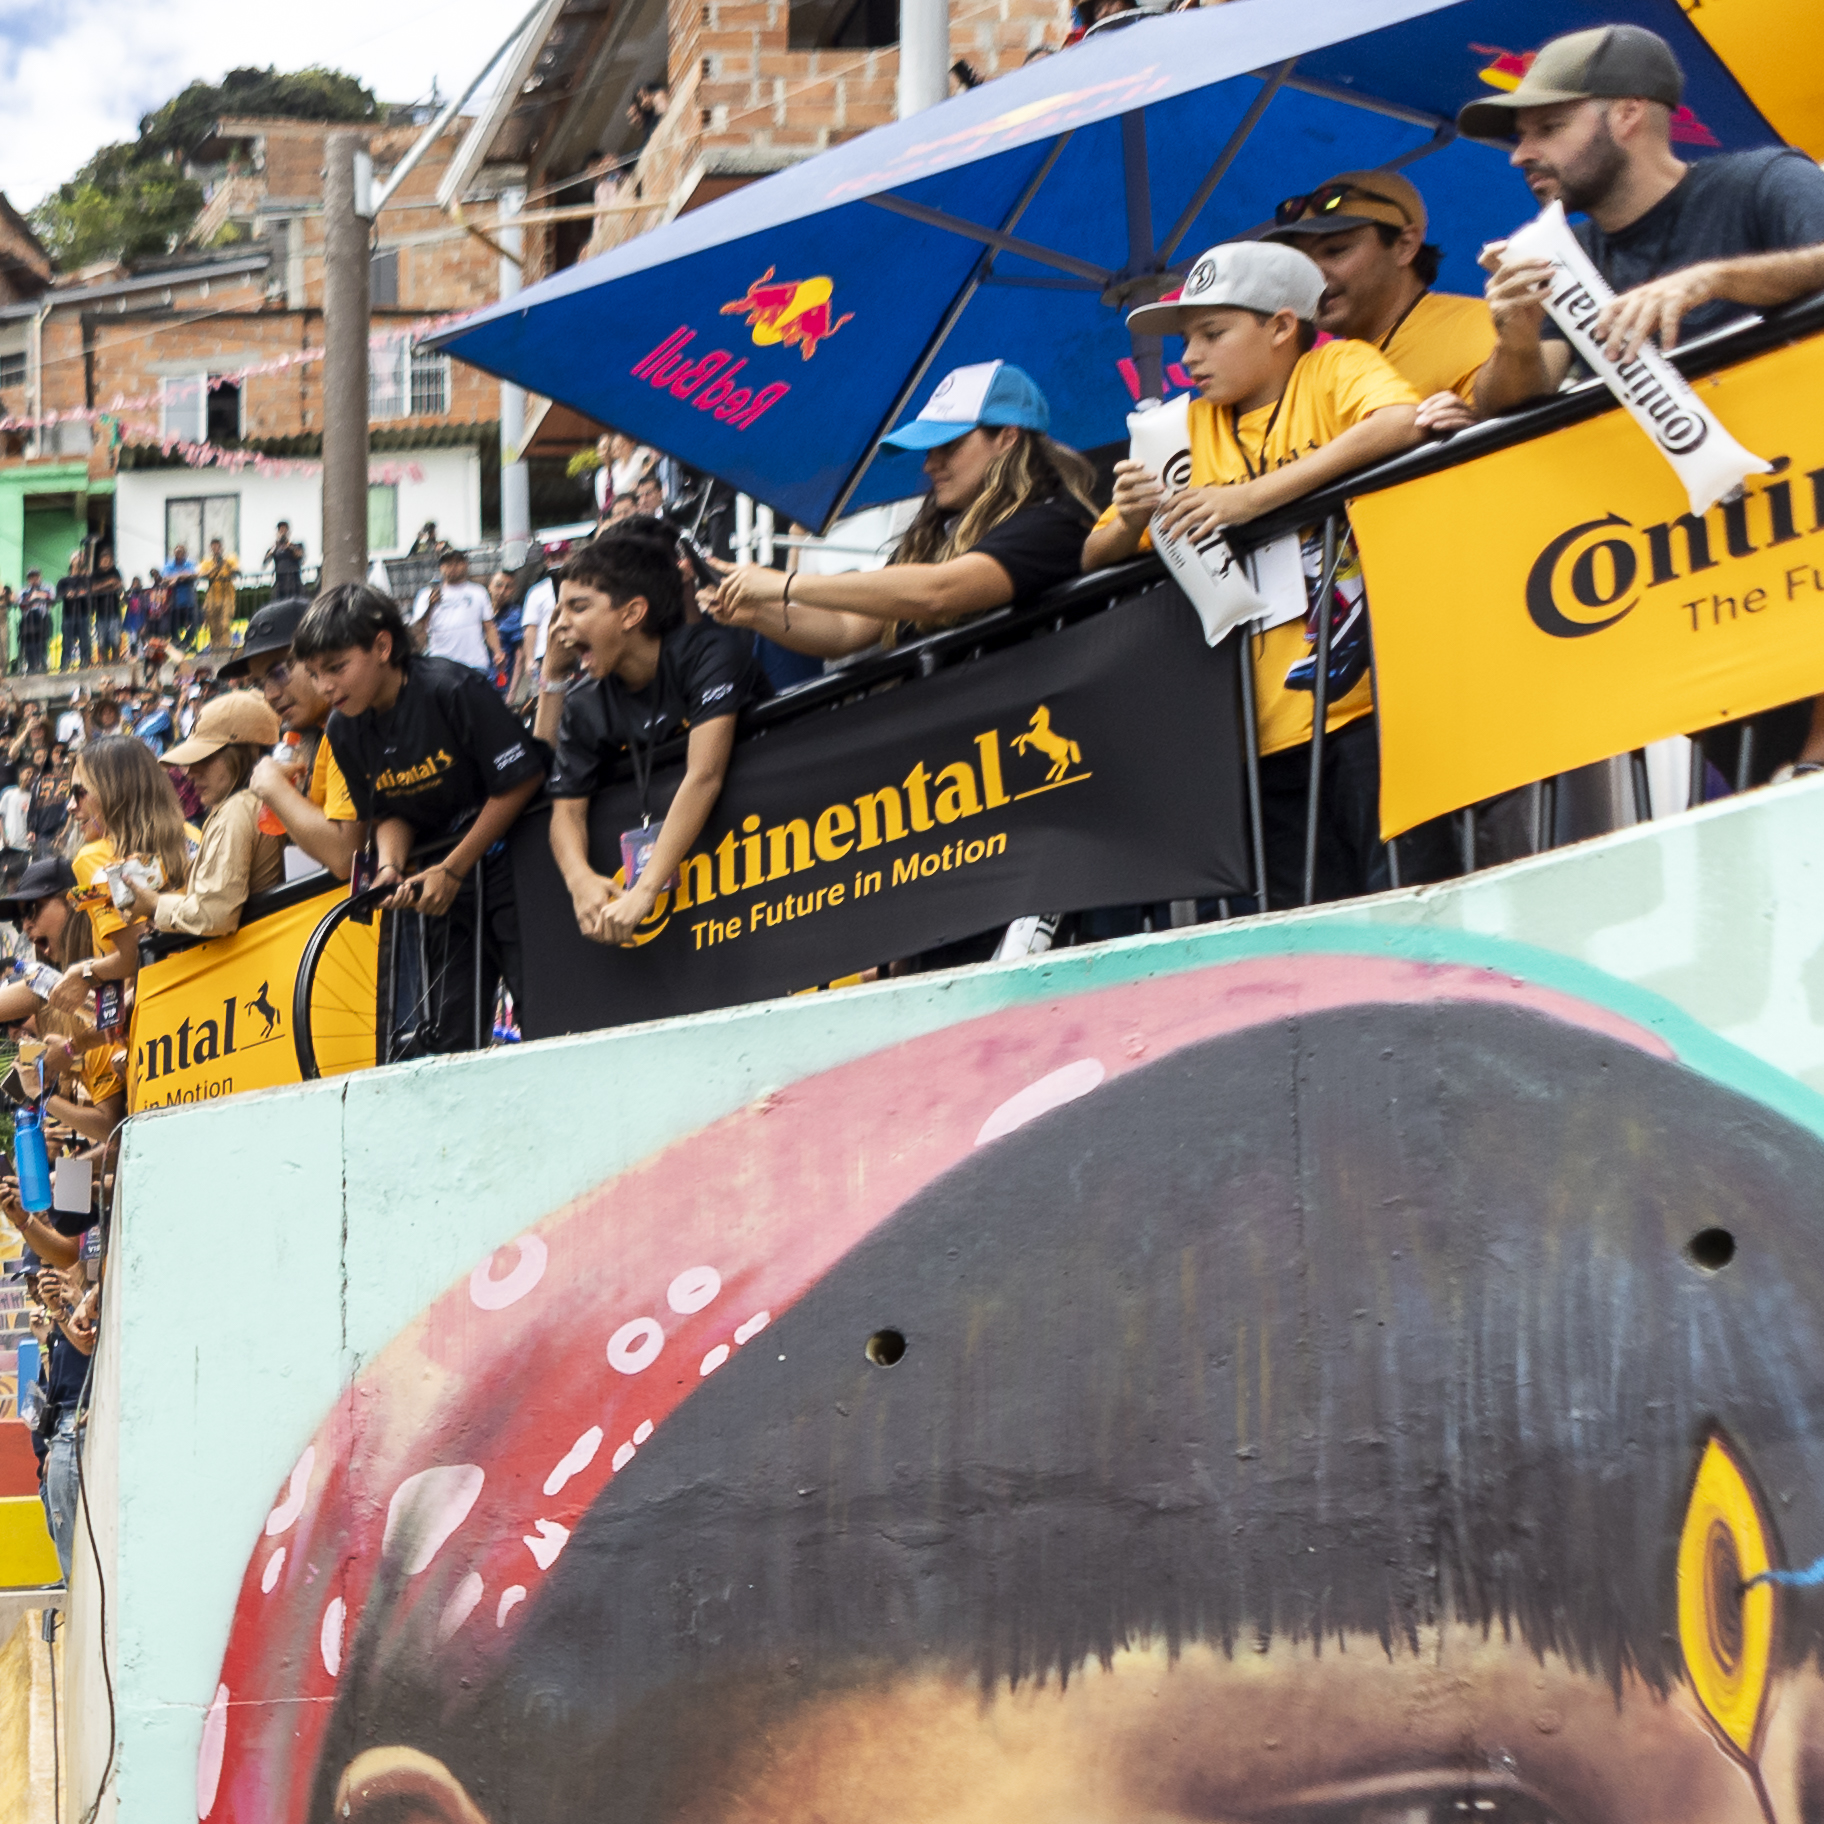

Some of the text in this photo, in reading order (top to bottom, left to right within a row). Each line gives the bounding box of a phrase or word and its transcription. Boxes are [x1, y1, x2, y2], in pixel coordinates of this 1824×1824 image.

[1682, 583, 1767, 632] The
[610, 729, 1014, 948] ntinental
[692, 832, 1008, 950] The Future in Motion
[167, 1077, 234, 1109] Motion
